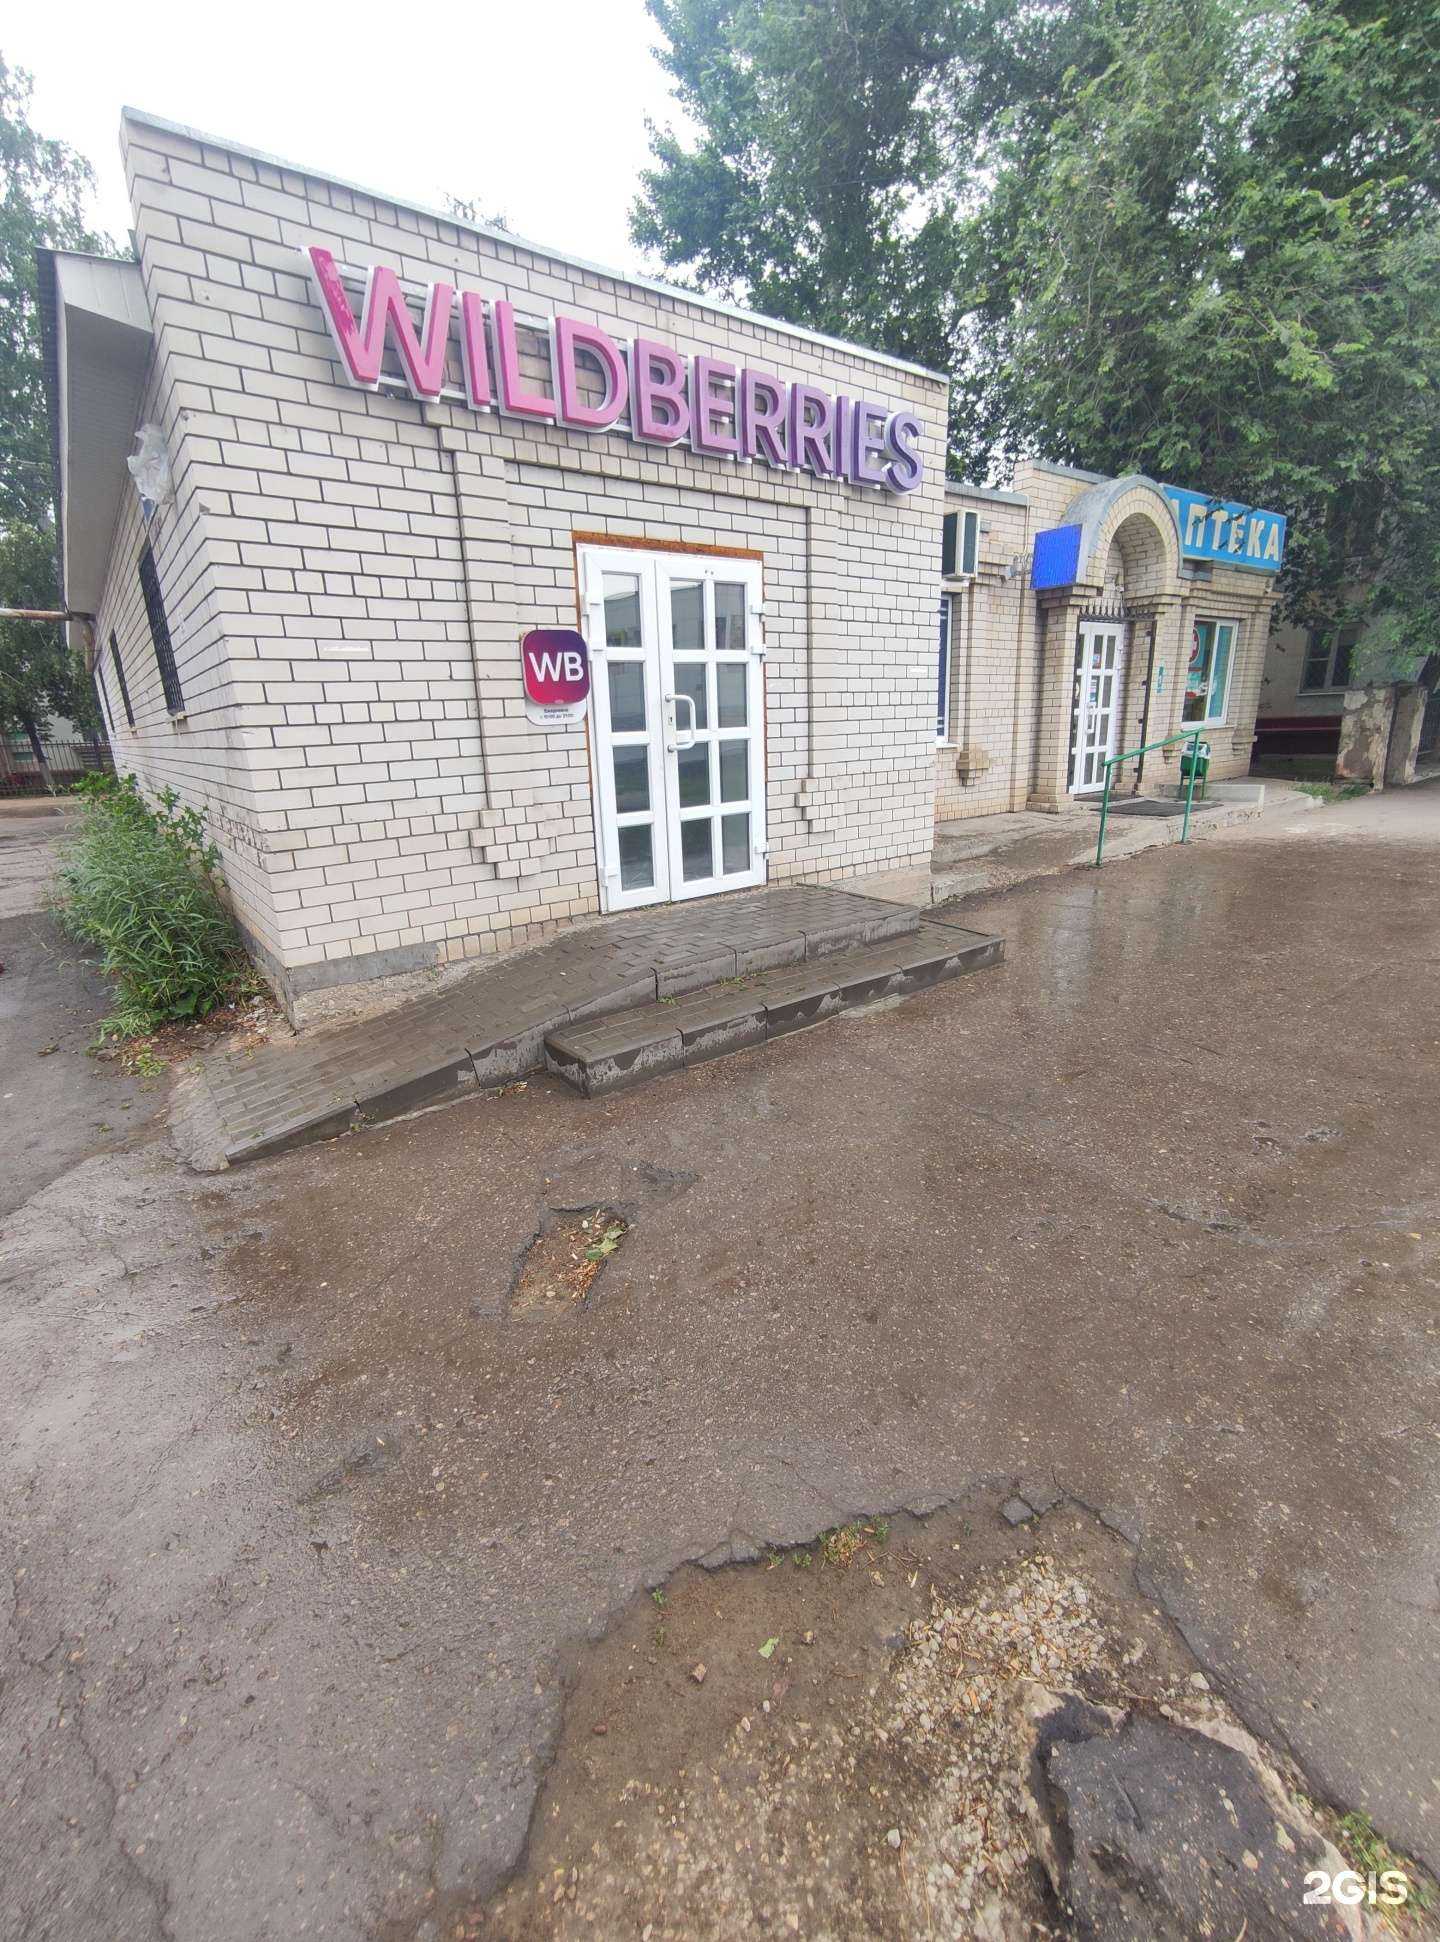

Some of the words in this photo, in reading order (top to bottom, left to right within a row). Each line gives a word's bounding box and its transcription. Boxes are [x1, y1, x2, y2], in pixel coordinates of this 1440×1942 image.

[301, 246, 926, 495] WILDBERRIES
[1171, 499, 1279, 561] ПТЕКА
[528, 652, 584, 682] WB
